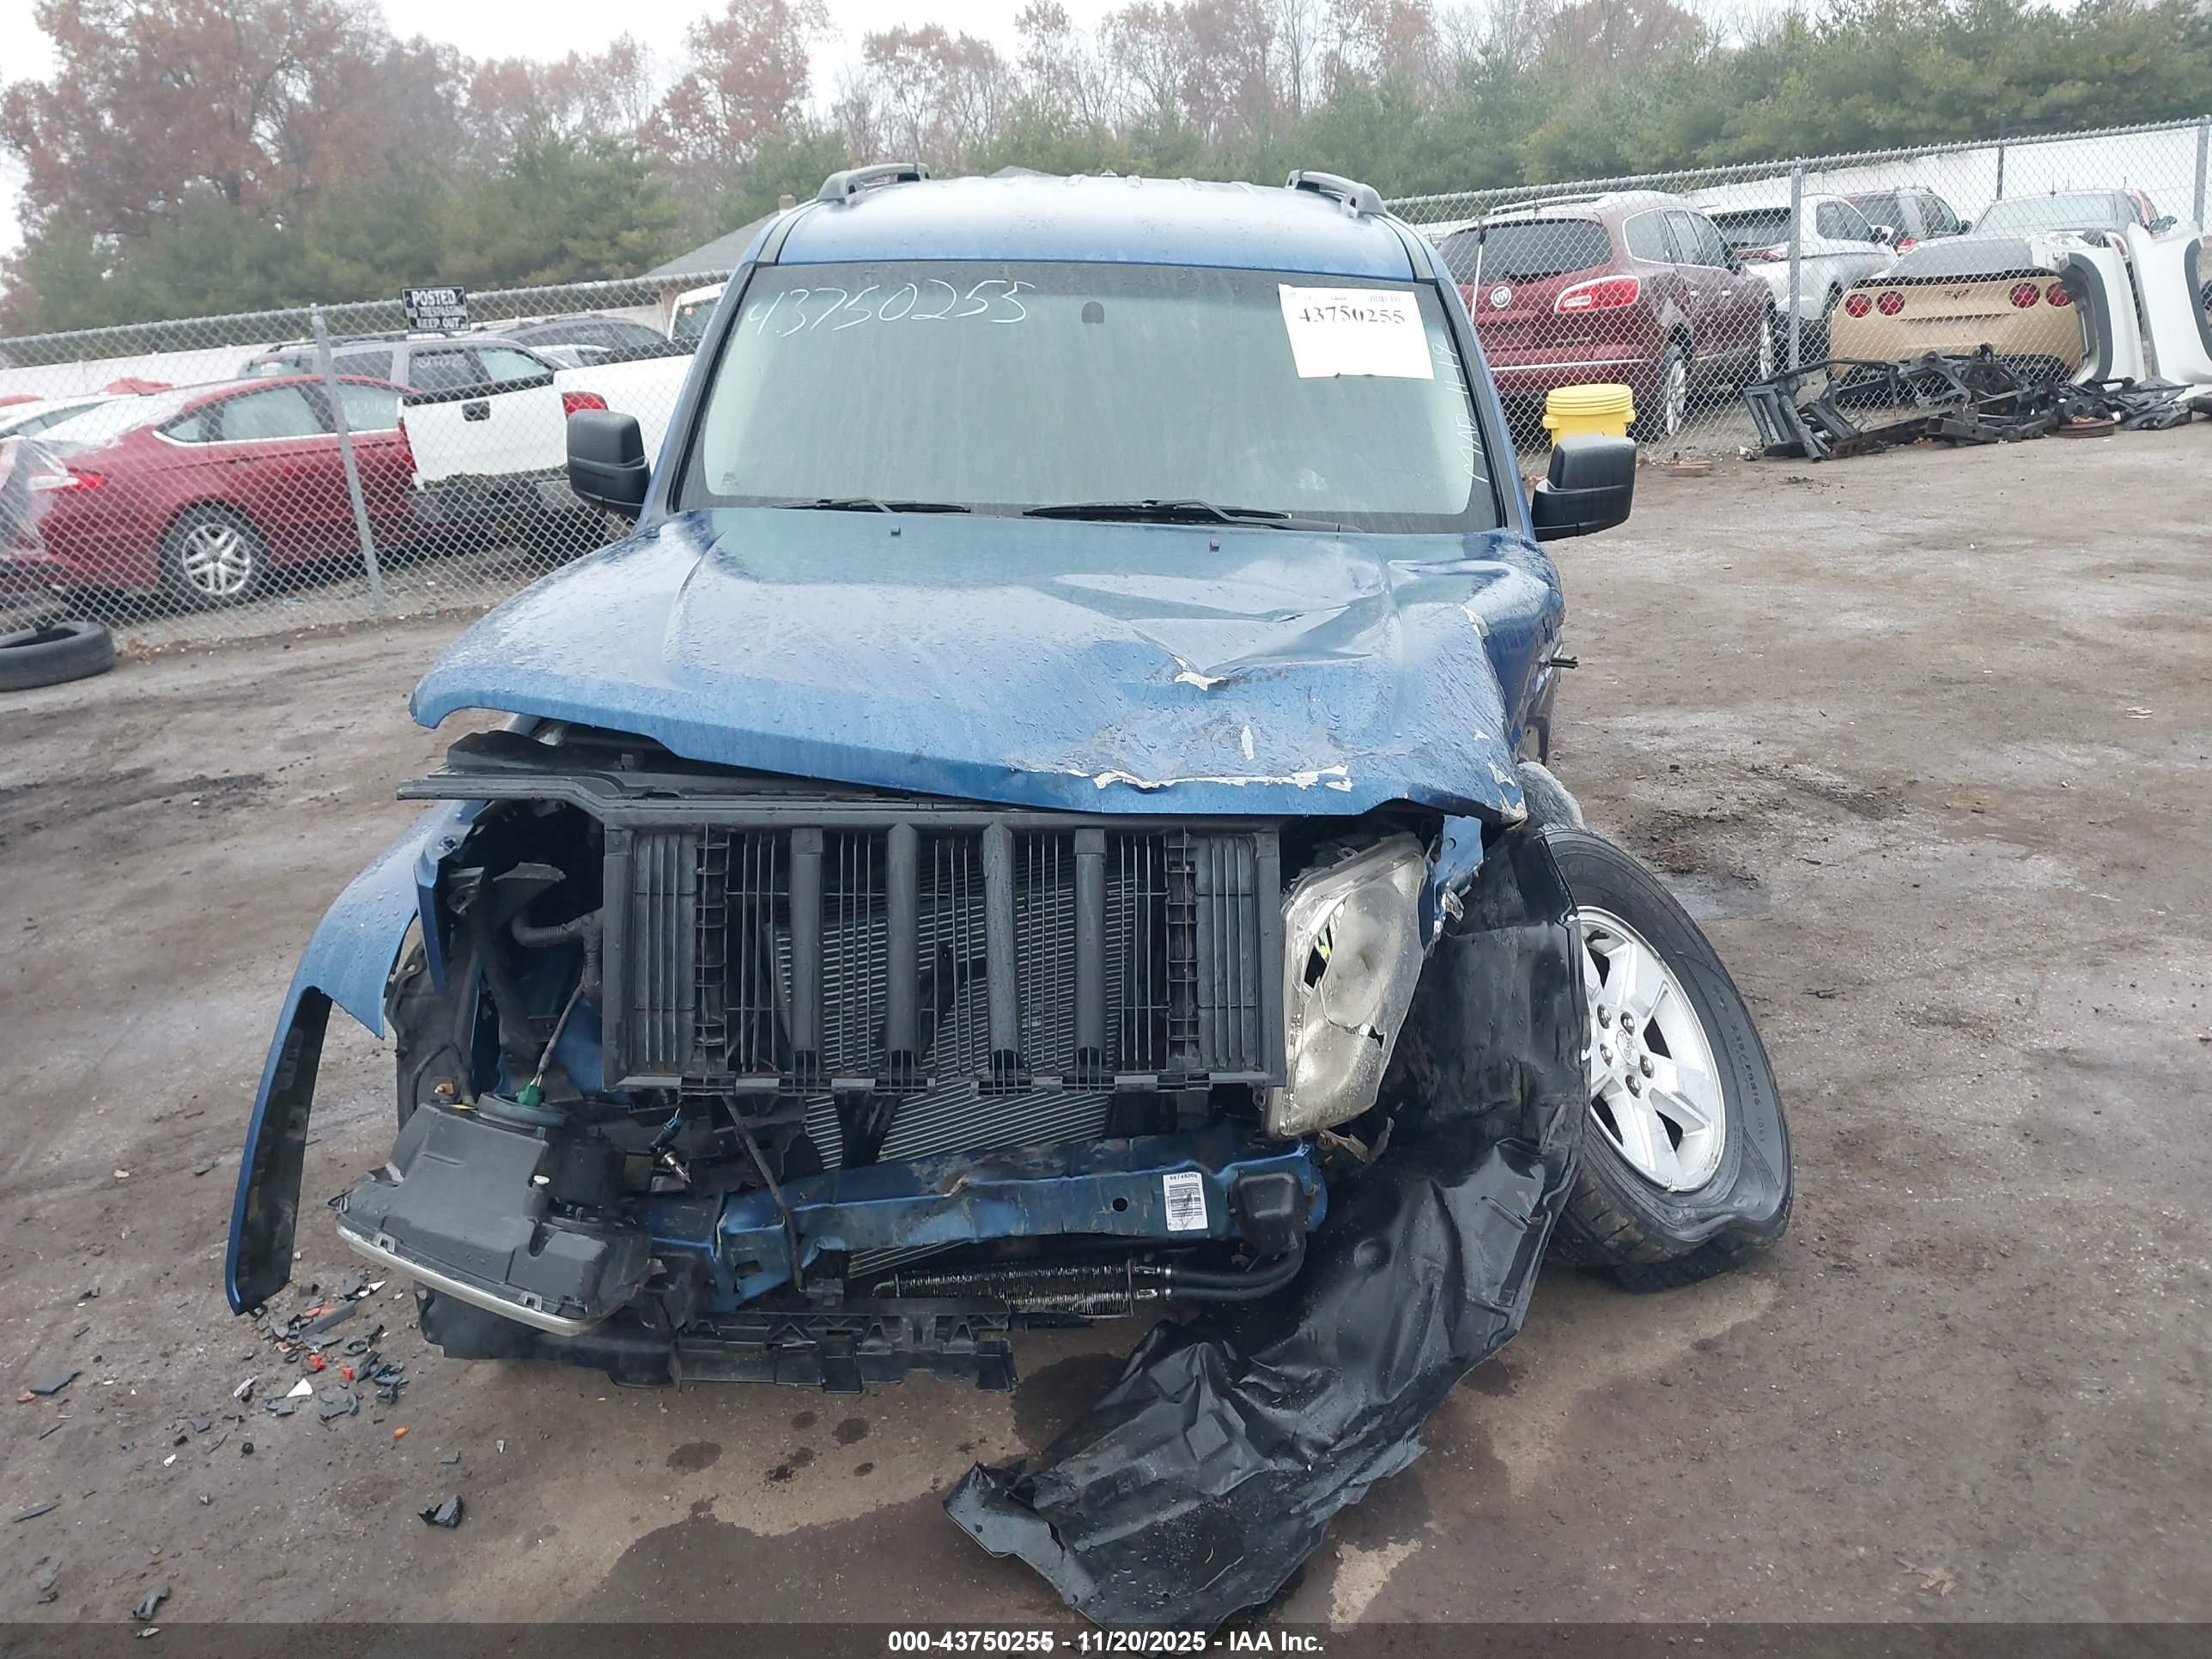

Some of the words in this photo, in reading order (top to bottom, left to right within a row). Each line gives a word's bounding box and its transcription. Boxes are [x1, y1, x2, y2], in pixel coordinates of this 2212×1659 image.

[411, 289, 456, 306] POSTED
[749, 279, 1036, 337] 43750255
[1299, 306, 1406, 324] 43750255
